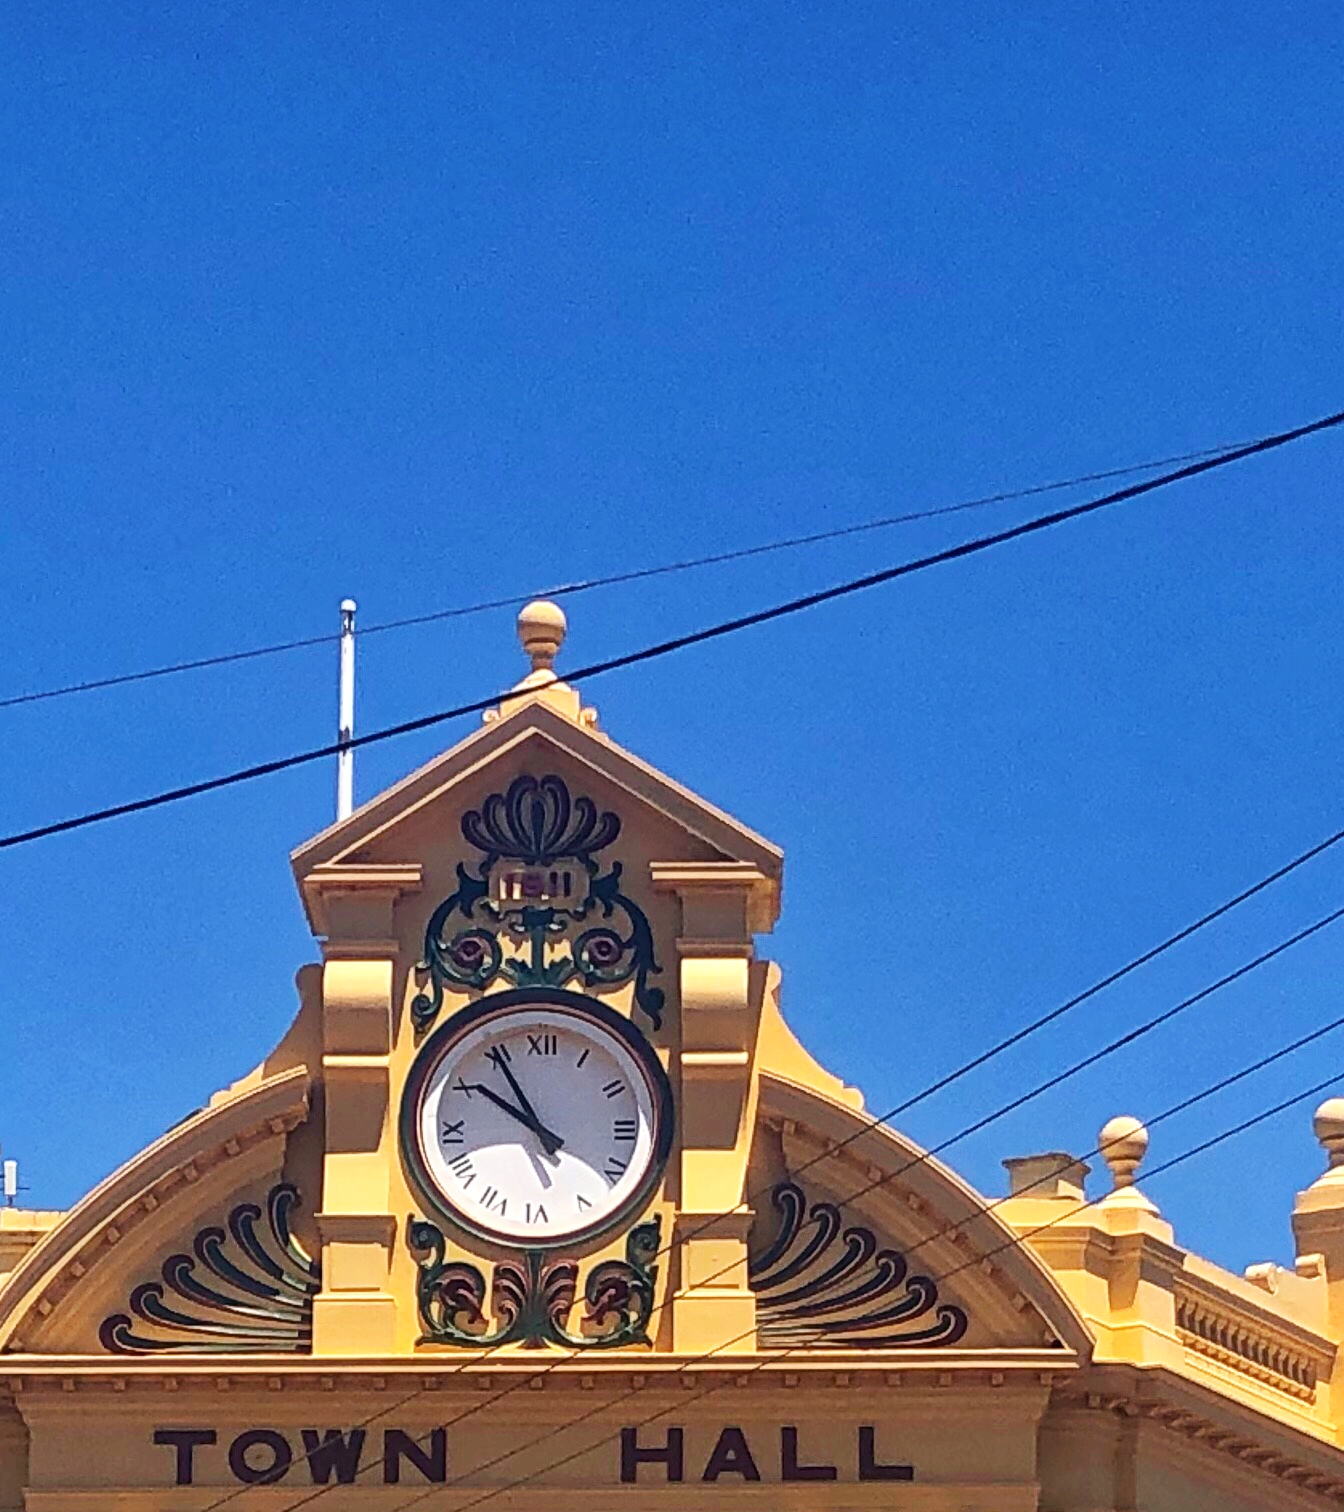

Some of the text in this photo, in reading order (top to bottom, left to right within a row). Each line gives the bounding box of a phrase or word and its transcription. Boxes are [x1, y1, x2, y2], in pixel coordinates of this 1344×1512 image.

[526, 1034, 558, 1056] XII
[576, 1048, 590, 1068] I
[602, 1079, 626, 1098] II
[442, 1119, 465, 1144] IX
[613, 1119, 636, 1141] III
[448, 1152, 478, 1190] VIII
[604, 1157, 628, 1186] IV
[479, 1186, 508, 1216] VII
[576, 1193, 593, 1213] V
[525, 1203, 549, 1224] VI
[153, 1426, 914, 1485] TOWN HALL
